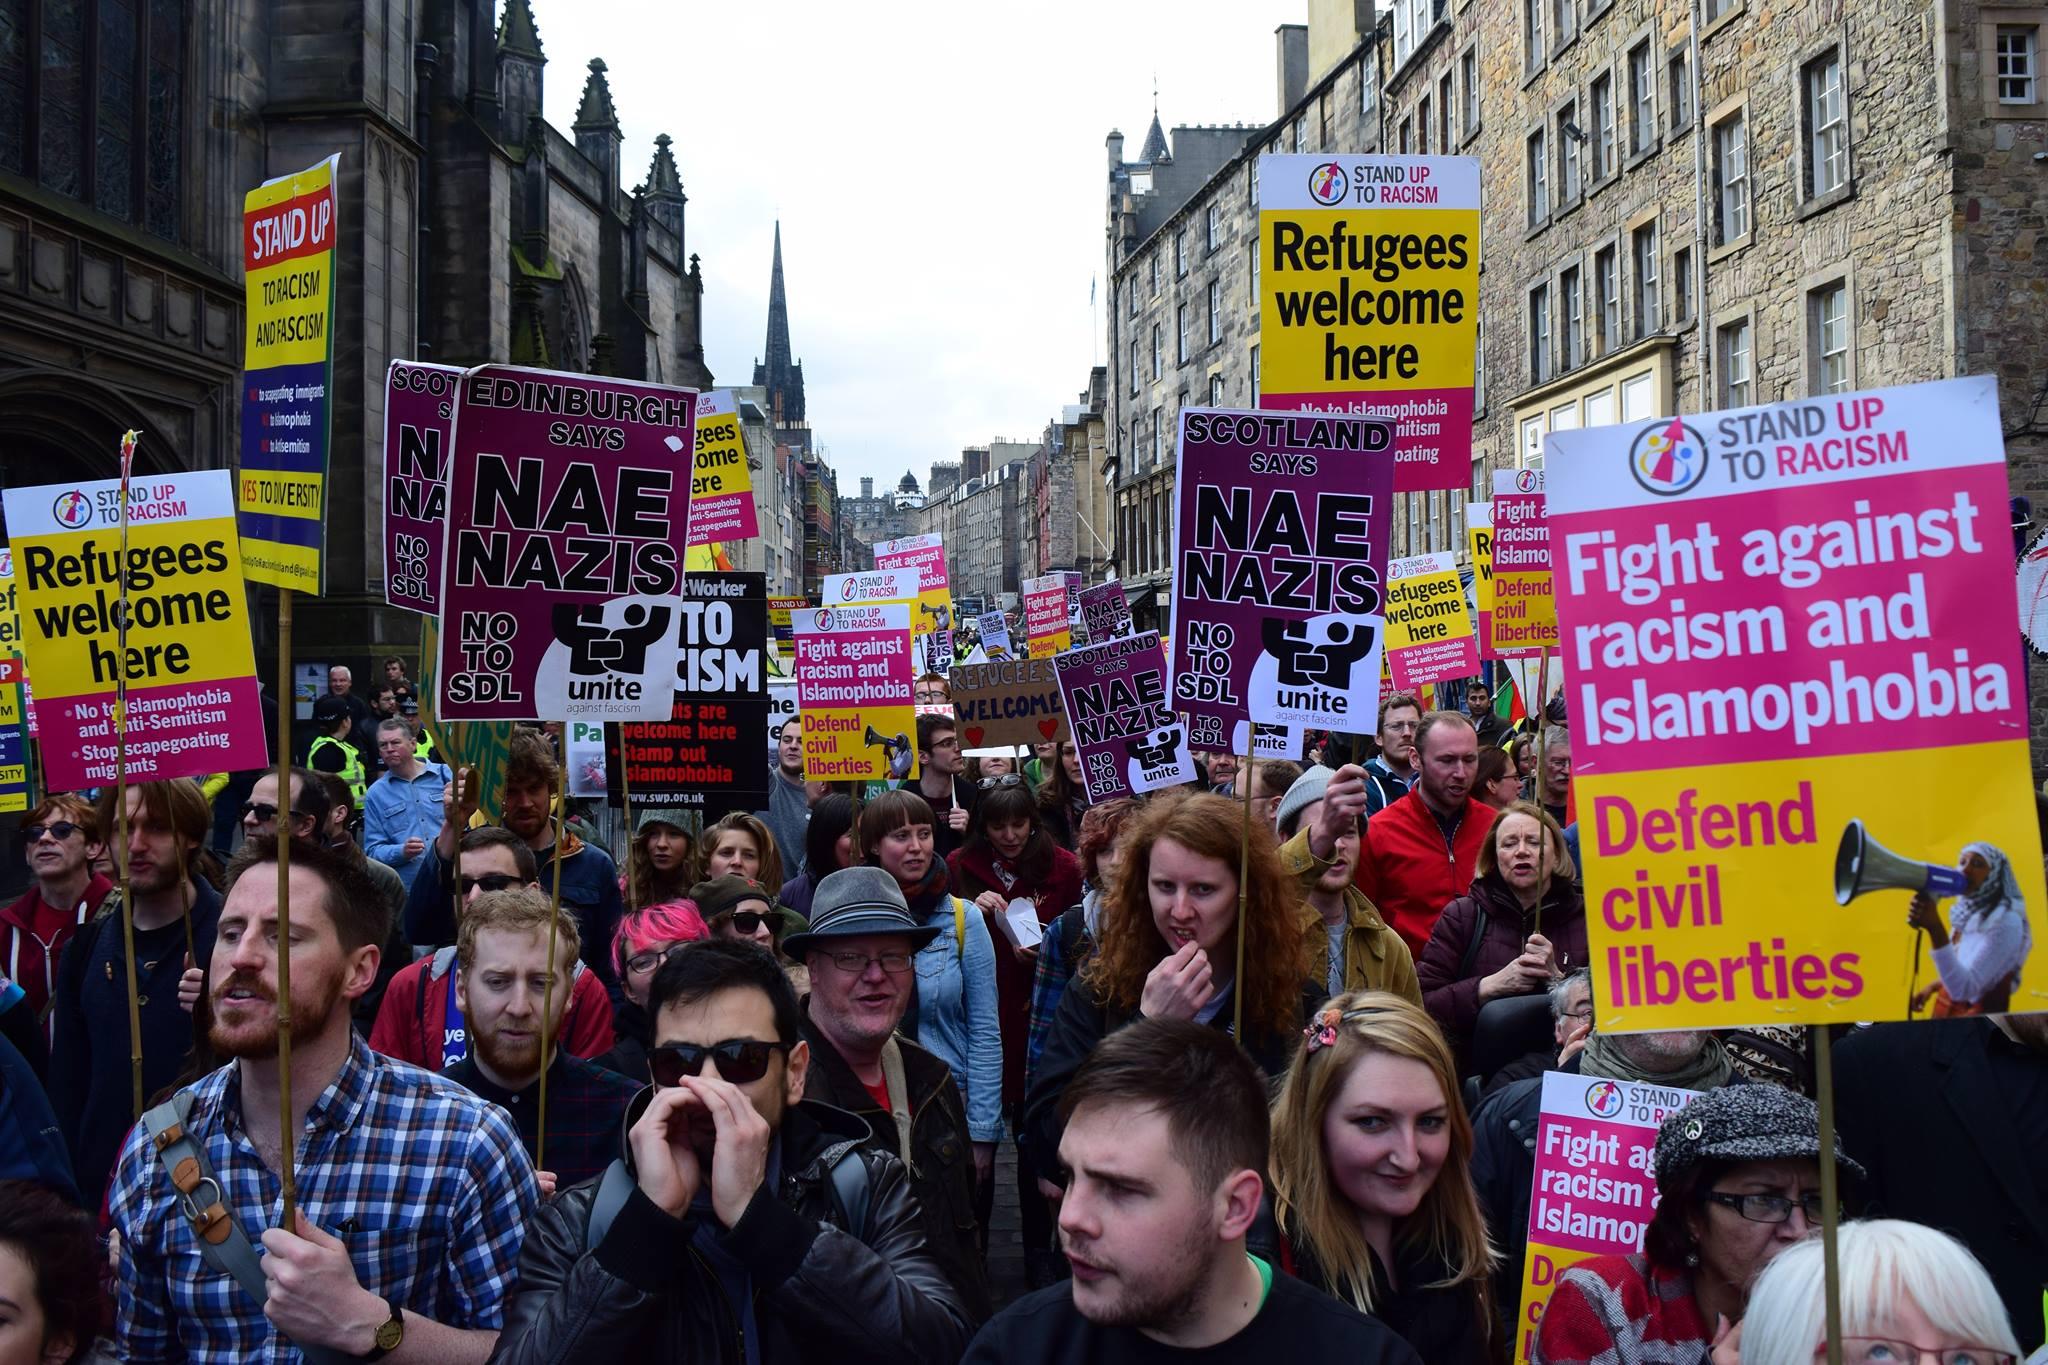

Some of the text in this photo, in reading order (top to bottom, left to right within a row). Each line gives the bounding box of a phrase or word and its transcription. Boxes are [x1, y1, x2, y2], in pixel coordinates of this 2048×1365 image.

[1354, 166, 1431, 184] STAND UP
[1354, 186, 1438, 204] TO RACISM
[253, 199, 331, 260] STAND UP
[1273, 221, 1468, 283] Refugees
[263, 270, 320, 307] TO RACISM
[1275, 277, 1464, 327] welcome
[256, 312, 324, 348] AND FASCISM
[1324, 332, 1419, 382] here
[466, 375, 688, 429] EDINBURGH
[1185, 414, 1391, 452] SCOTLAND
[1718, 397, 1885, 449] STAND UP
[549, 422, 626, 452] SAYS
[1250, 452, 1318, 477] SAYS
[1721, 430, 1910, 483] TO RACISM
[97, 485, 176, 507] STAND UP
[242, 479, 320, 509] YES TO DIVERSITY
[471, 453, 673, 541] NAE
[692, 497, 742, 512] Islamophobia
[99, 501, 187, 523] TO RACISM
[1194, 484, 1373, 562] NAE
[1497, 500, 1538, 524] Fight
[693, 518, 742, 532] scapegoating
[1496, 522, 1550, 542] racism
[395, 533, 429, 561] NO
[1565, 492, 1983, 606] Fight against
[23, 540, 228, 591] Refugees
[395, 556, 428, 581] TO
[455, 529, 678, 596] NAZIS
[878, 550, 940, 570] Fight against
[1403, 557, 1433, 568] STAND UP
[1404, 564, 1439, 576] TO RACISM
[391, 574, 435, 604] SDL
[688, 578, 747, 597] Worker
[859, 587, 898, 599] TO RACISM
[860, 576, 895, 588] STAND UP
[1183, 550, 1380, 616] NAZIS
[1496, 577, 1552, 598] Defend
[771, 600, 807, 609] STAND UP
[1027, 592, 1065, 611] Fight against
[1086, 595, 1123, 620] NAE
[1385, 599, 1461, 625] welcome
[1495, 600, 1527, 619] civil
[34, 589, 231, 639] welcome
[682, 600, 733, 646] TO
[837, 608, 881, 620] STAND UP
[837, 618, 886, 629] TO RACISM
[1028, 605, 1062, 623] racism and
[1029, 617, 1069, 635] Islamophobia
[1087, 609, 1129, 632] NAZIS
[1574, 572, 1930, 672] racism and
[461, 611, 518, 643] NO
[1187, 620, 1235, 651] NO
[1408, 622, 1447, 642] here
[1495, 621, 1559, 642] liberties
[460, 642, 514, 673] TO
[798, 636, 903, 662] Fight against
[1031, 640, 1056, 654] Defend
[1056, 634, 1158, 671] SCOTLAND
[1403, 641, 1465, 659] No to Islamophobia
[1406, 650, 1463, 667] and anti-Semitism
[89, 640, 190, 683] here
[674, 647, 760, 692] CISM
[800, 661, 853, 680] racism
[857, 658, 889, 678] and
[1094, 659, 1128, 676] SAYS
[1187, 648, 1232, 677] TO
[1407, 659, 1467, 677] Stop scapegoating
[448, 672, 522, 704] SDL
[568, 674, 642, 701] unite
[1176, 674, 1239, 705] SDL
[1409, 673, 1439, 685] migrants
[801, 679, 910, 704] Islamophobia
[1072, 669, 1166, 721] NAE
[1276, 687, 1348, 715] unite
[1581, 647, 2010, 746] Islamophobia
[75, 704, 98, 719] No
[124, 689, 231, 715] Islamophobia
[566, 702, 641, 715] against fascism
[700, 704, 727, 720] are
[954, 690, 1064, 722] WELCOME
[79, 720, 109, 738] and
[624, 721, 737, 740] welcome here
[805, 713, 861, 733] Defend
[1075, 701, 1178, 747] NAZIS
[1197, 715, 1223, 731] TO
[1275, 711, 1348, 727] against fascism
[82, 731, 230, 761] Stop scapegoating
[806, 736, 838, 754] civil
[1190, 730, 1228, 746] SDL
[624, 743, 707, 763] Stamp out
[1088, 752, 1114, 769] NO
[86, 757, 157, 780] migants
[626, 764, 734, 784] slamophobia
[808, 757, 873, 775] liberties
[1092, 765, 1117, 782] TO
[1143, 765, 1180, 782] unite
[1090, 780, 1126, 796] SDL
[1593, 781, 1818, 858] Defend
[1601, 864, 1723, 933] civil
[1606, 938, 1865, 1009] liberties
[1630, 1086, 1680, 1108] STAND
[1628, 1105, 1650, 1122] TO
[1544, 1123, 1620, 1168] Fight
[1540, 1167, 1643, 1208] racism
